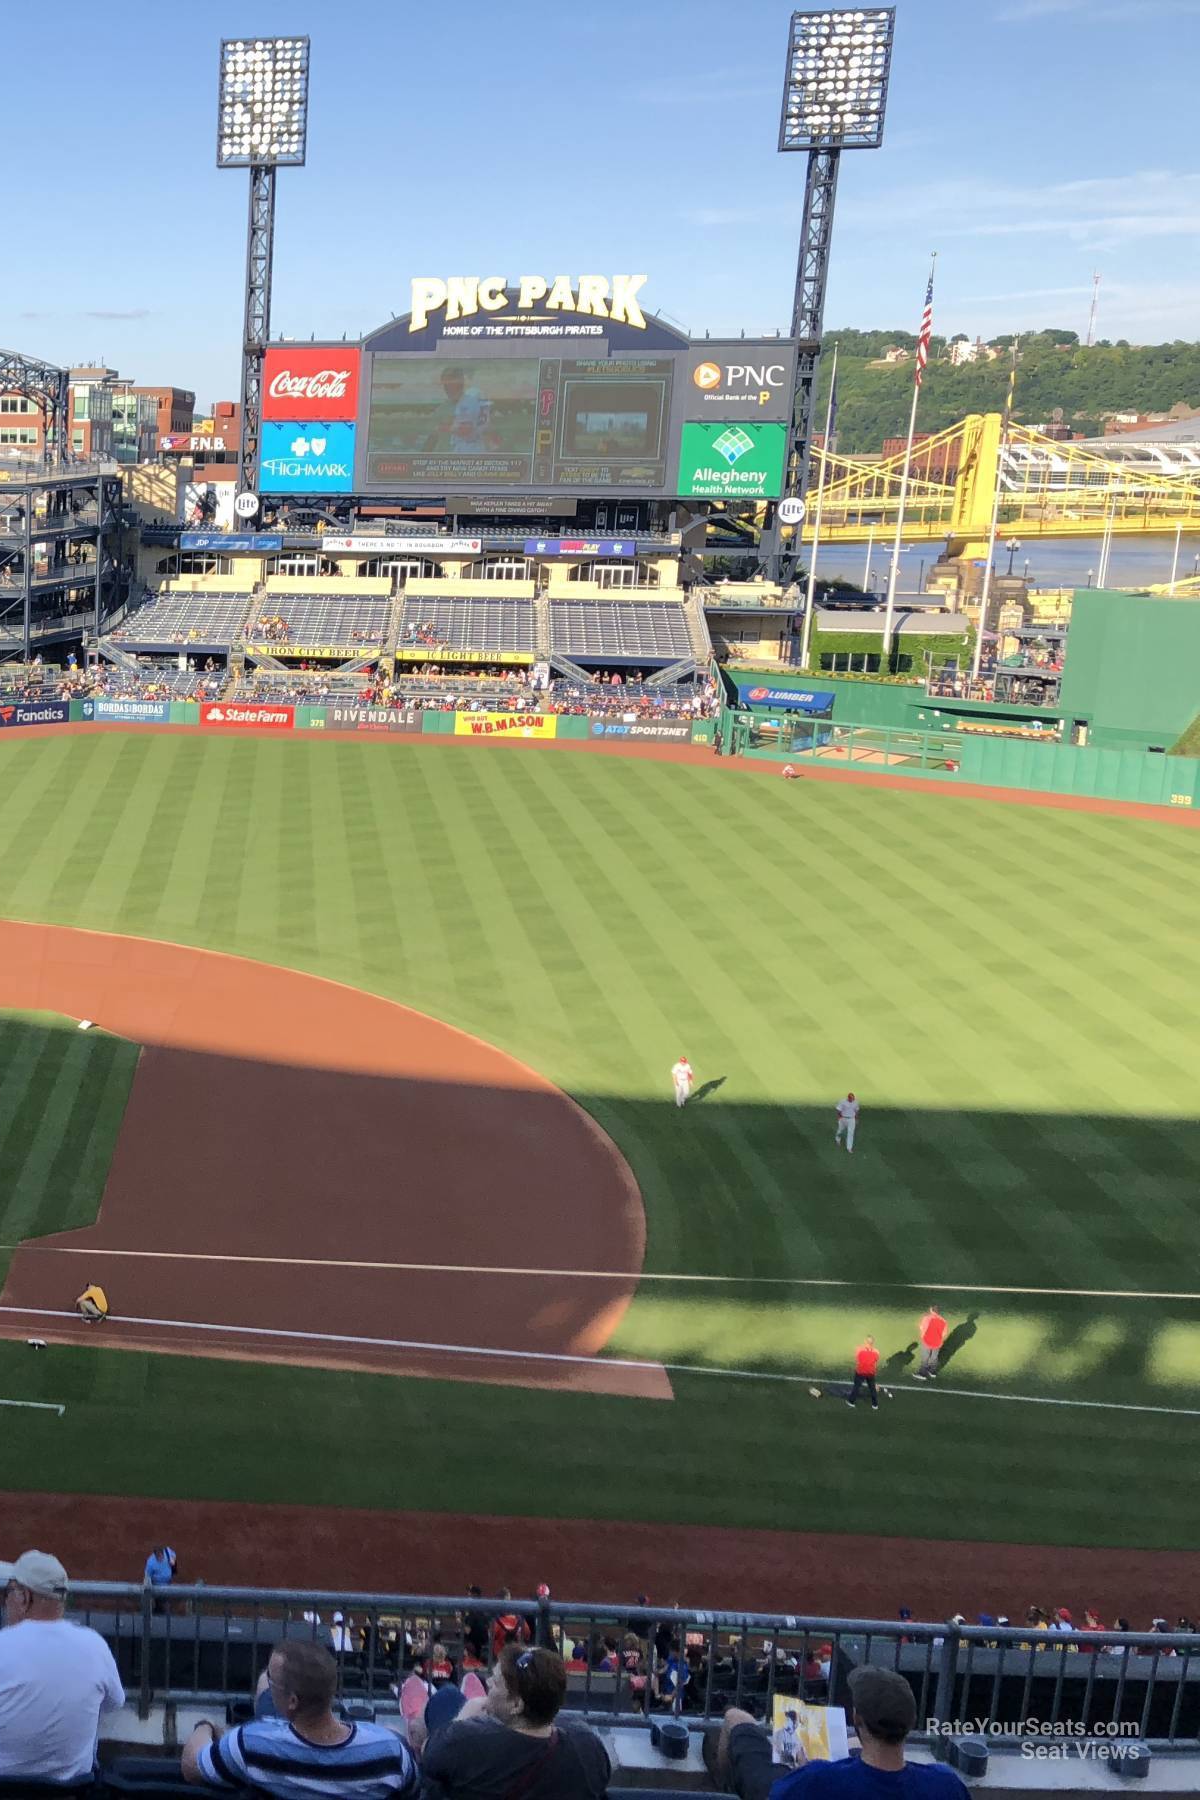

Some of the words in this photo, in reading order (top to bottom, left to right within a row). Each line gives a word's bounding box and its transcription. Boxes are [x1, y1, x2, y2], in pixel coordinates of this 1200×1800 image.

[408, 276, 509, 334] PNC
[517, 274, 648, 331] PARK
[443, 326, 468, 336] HOME
[471, 326, 484, 336] OF
[486, 326, 504, 336] THE
[505, 325, 563, 336] PITTSBURGH
[565, 325, 603, 336] PIRATES
[725, 365, 785, 387] PNC
[190, 437, 226, 450] F.N.B.
[271, 461, 348, 477] HIGHMARK
[692, 468, 767, 485] Allegheny
[692, 485, 723, 494] Health
[725, 485, 764, 494] Network
[238, 498, 256, 511] Lite
[782, 502, 803, 516] Lite
[266, 647, 289, 656] IRON
[292, 647, 317, 656] CITY
[320, 648, 359, 657] BEER
[427, 652, 437, 660] IC
[438, 652, 474, 661] LIGHT
[477, 652, 502, 662] BEER
[768, 691, 814, 702] LUMBER
[98, 702, 129, 713] BORDAS
[132, 704, 164, 714] BORDAS
[16, 708, 63, 722] Fanatics
[334, 709, 414, 724] RIVENDALE
[605, 725, 630, 734] AT&T
[630, 726, 688, 736] SPORTSNET
[1171, 794, 1192, 805] 399
